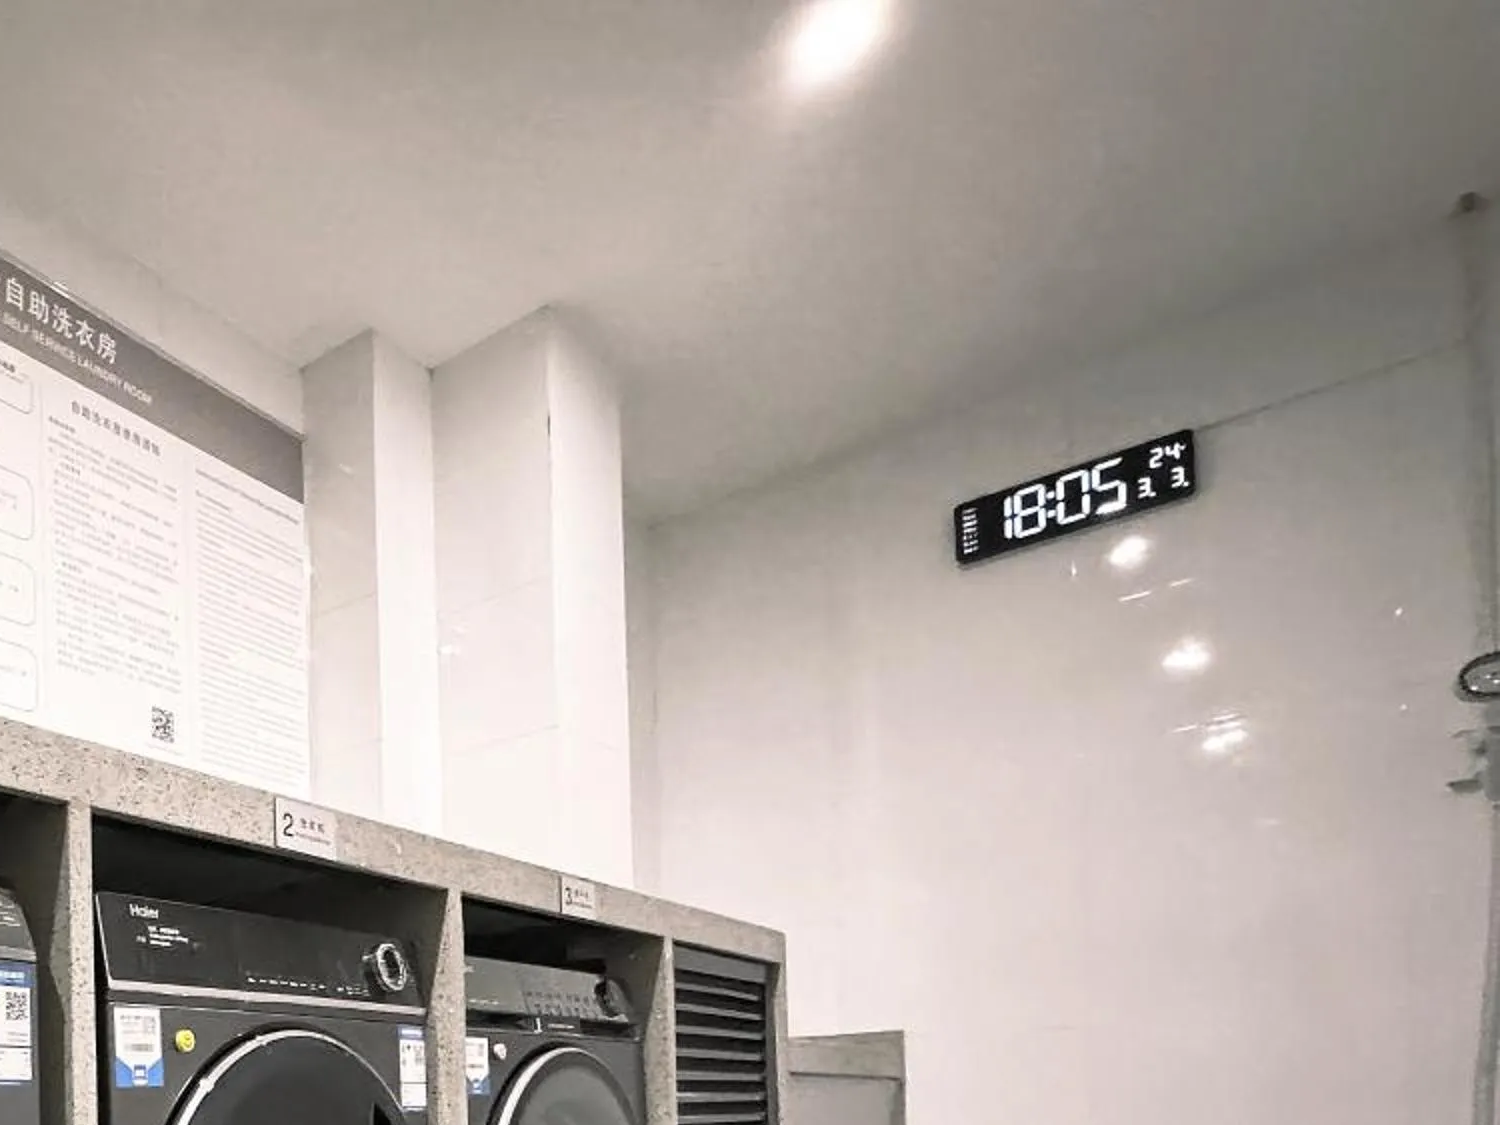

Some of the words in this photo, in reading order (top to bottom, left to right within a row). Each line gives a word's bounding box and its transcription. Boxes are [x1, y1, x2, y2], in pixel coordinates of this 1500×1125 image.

[1149, 442, 1186, 469] 24
[1003, 457, 1127, 540] 18:05
[283, 812, 293, 837] 2
[565, 887, 573, 905] 3
[129, 903, 159, 920] Haier
